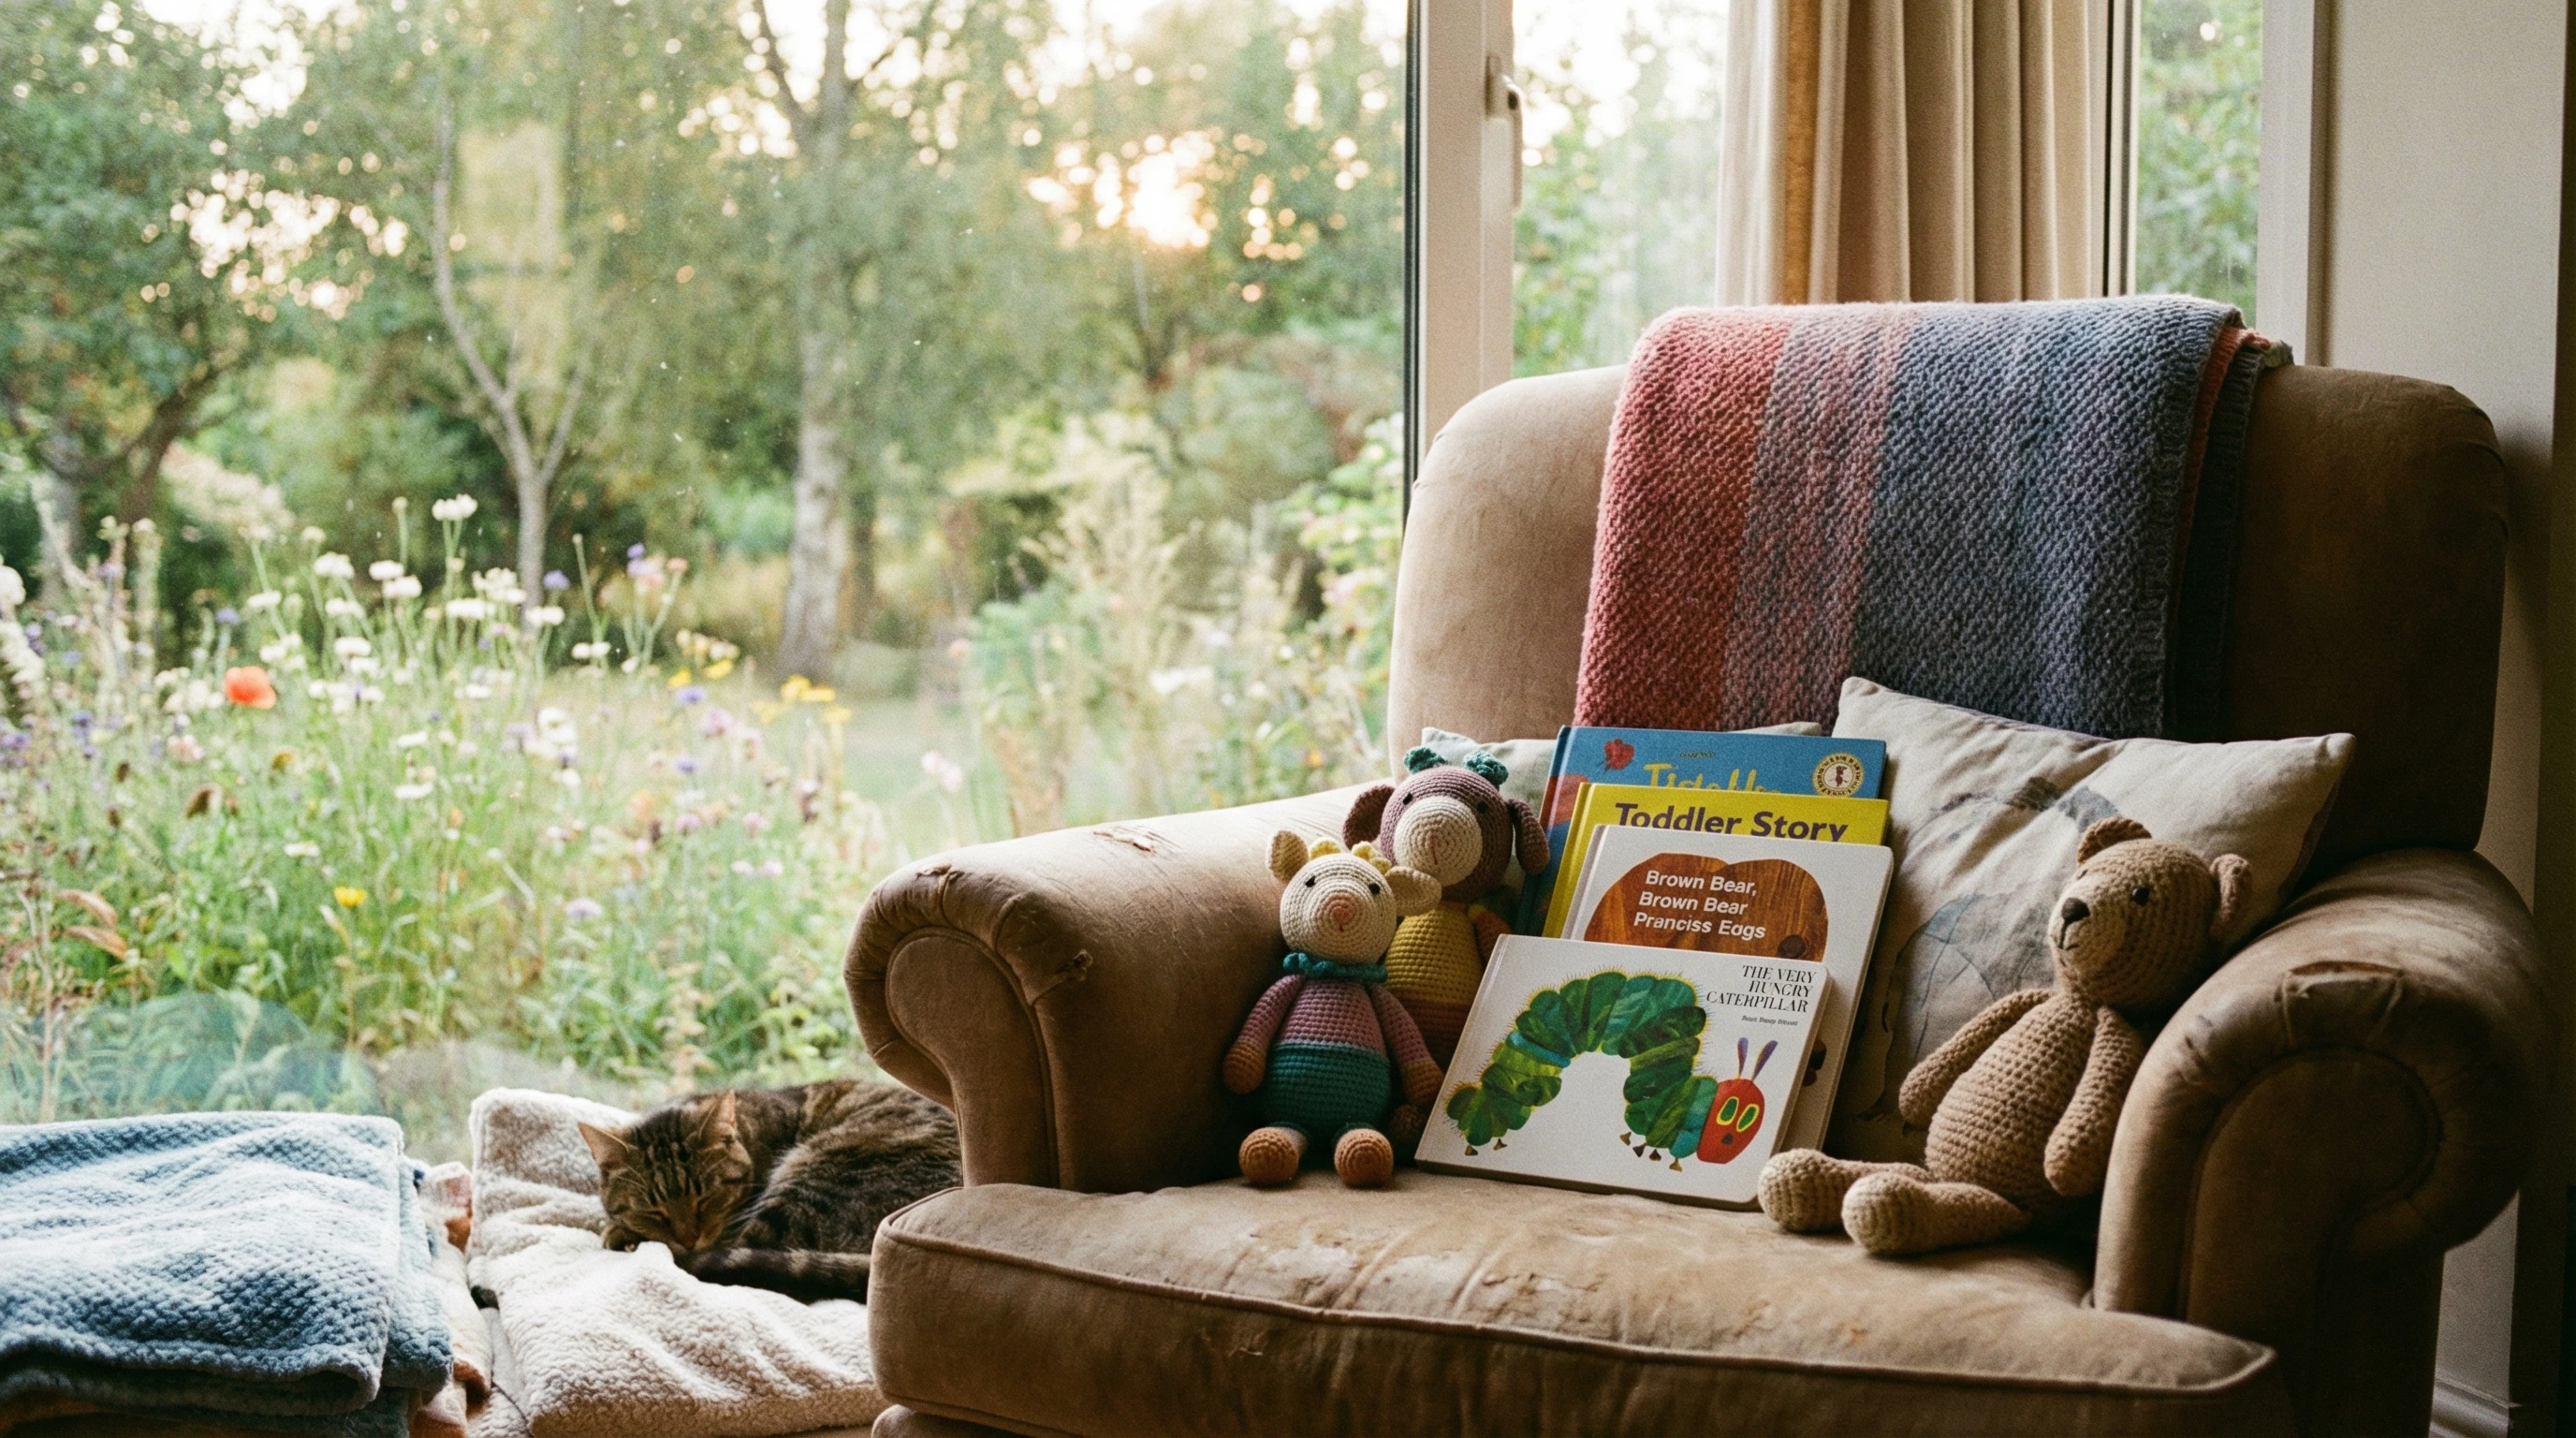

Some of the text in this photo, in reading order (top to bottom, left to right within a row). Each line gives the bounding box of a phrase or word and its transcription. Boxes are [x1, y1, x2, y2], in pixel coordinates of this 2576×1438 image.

[1615, 802, 1849, 842] Toddler Story
[1645, 870, 1757, 897] Brown Bear,
[1638, 890, 1749, 915] Brown Bear
[1632, 911, 1712, 933] Pranciss
[1742, 964, 1816, 984] THE VERY
